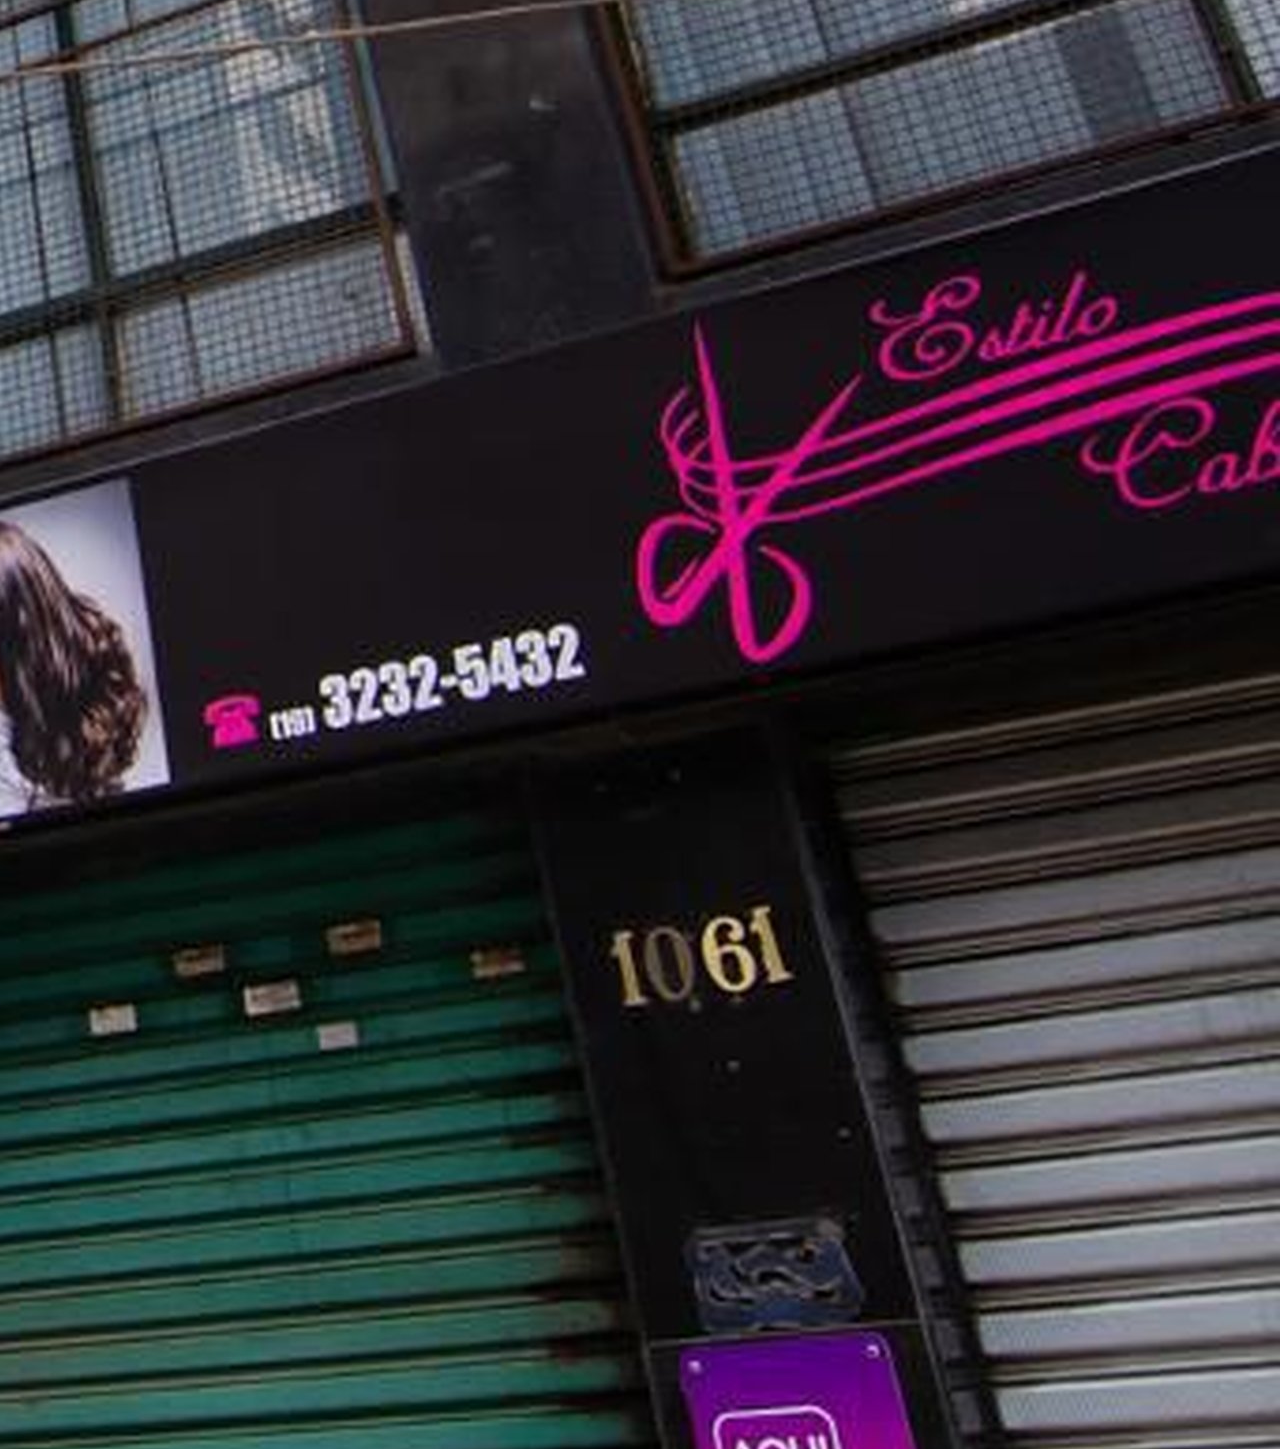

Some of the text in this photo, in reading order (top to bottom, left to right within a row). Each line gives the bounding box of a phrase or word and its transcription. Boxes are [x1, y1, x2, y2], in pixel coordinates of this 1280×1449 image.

[869, 271, 1117, 380] Estilo
[320, 624, 586, 729] 3232-5432
[611, 905, 795, 1007] 1061
